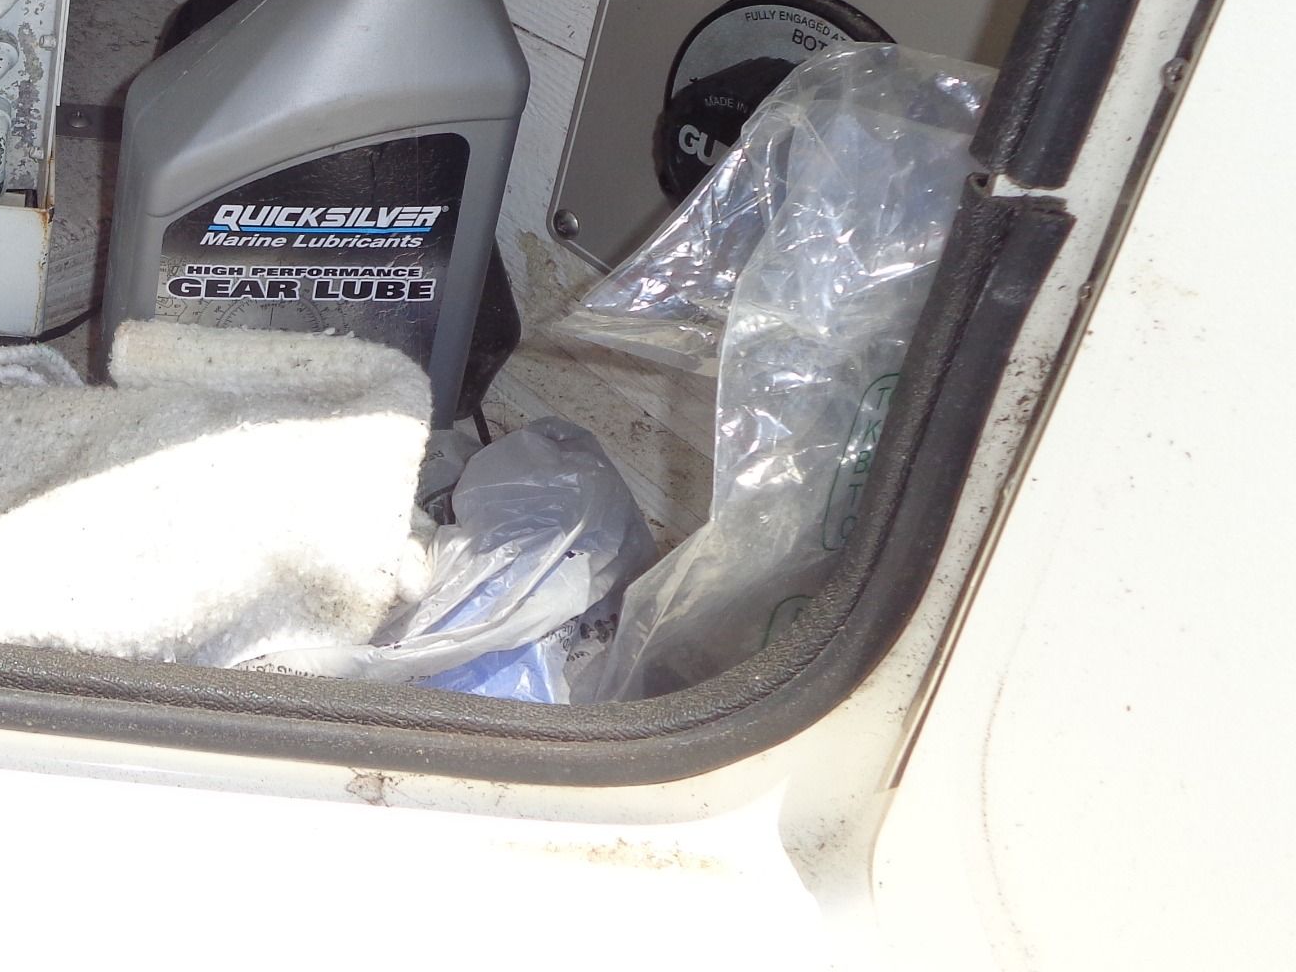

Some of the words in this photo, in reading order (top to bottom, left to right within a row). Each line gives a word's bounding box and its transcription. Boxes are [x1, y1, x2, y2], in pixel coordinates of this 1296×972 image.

[745, 10, 776, 22] FULLY
[779, 10, 831, 37] ENGAGED
[792, 28, 828, 52] BOT
[704, 95, 733, 108] MADE
[212, 204, 442, 231] QUICKSILVER
[200, 231, 287, 248] Marine
[292, 233, 423, 248] Lubricants
[186, 265, 244, 277] HIGH
[250, 266, 422, 278] PERFORMANCE
[167, 277, 300, 300] GEAR
[313, 279, 435, 300] LUBE
